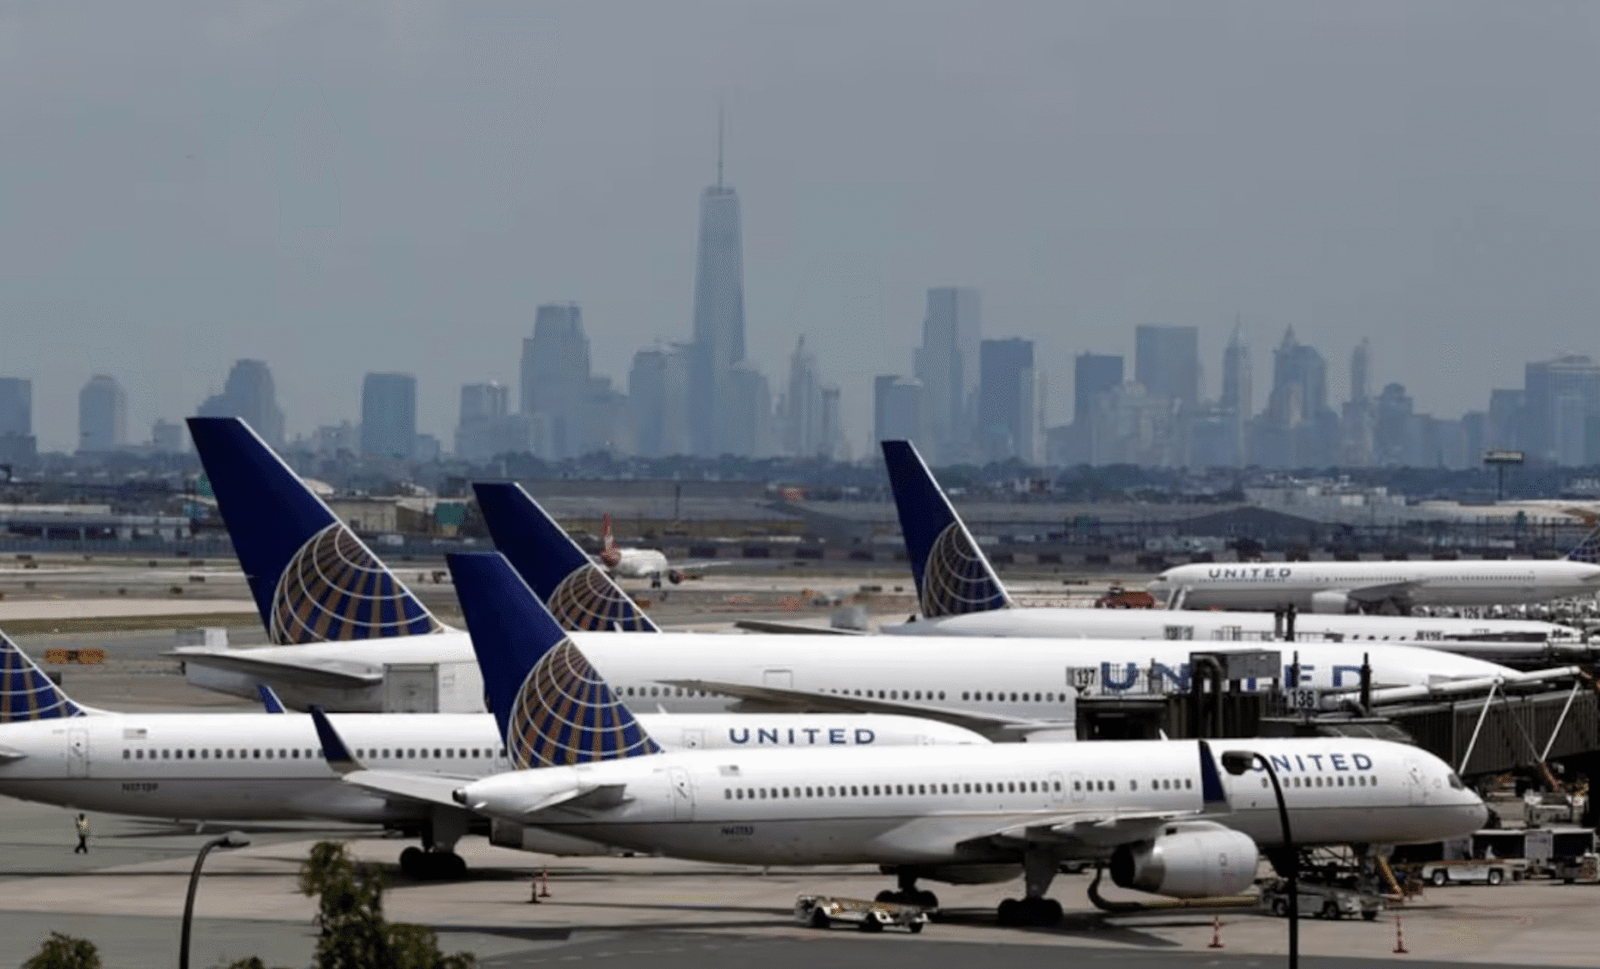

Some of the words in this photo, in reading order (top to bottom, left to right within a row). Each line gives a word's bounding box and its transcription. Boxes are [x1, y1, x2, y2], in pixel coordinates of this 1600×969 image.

[1208, 567, 1291, 579] UNITED
[1077, 667, 1095, 685] 137
[1101, 661, 1366, 689] UNED
[728, 728, 876, 745] UNITED
